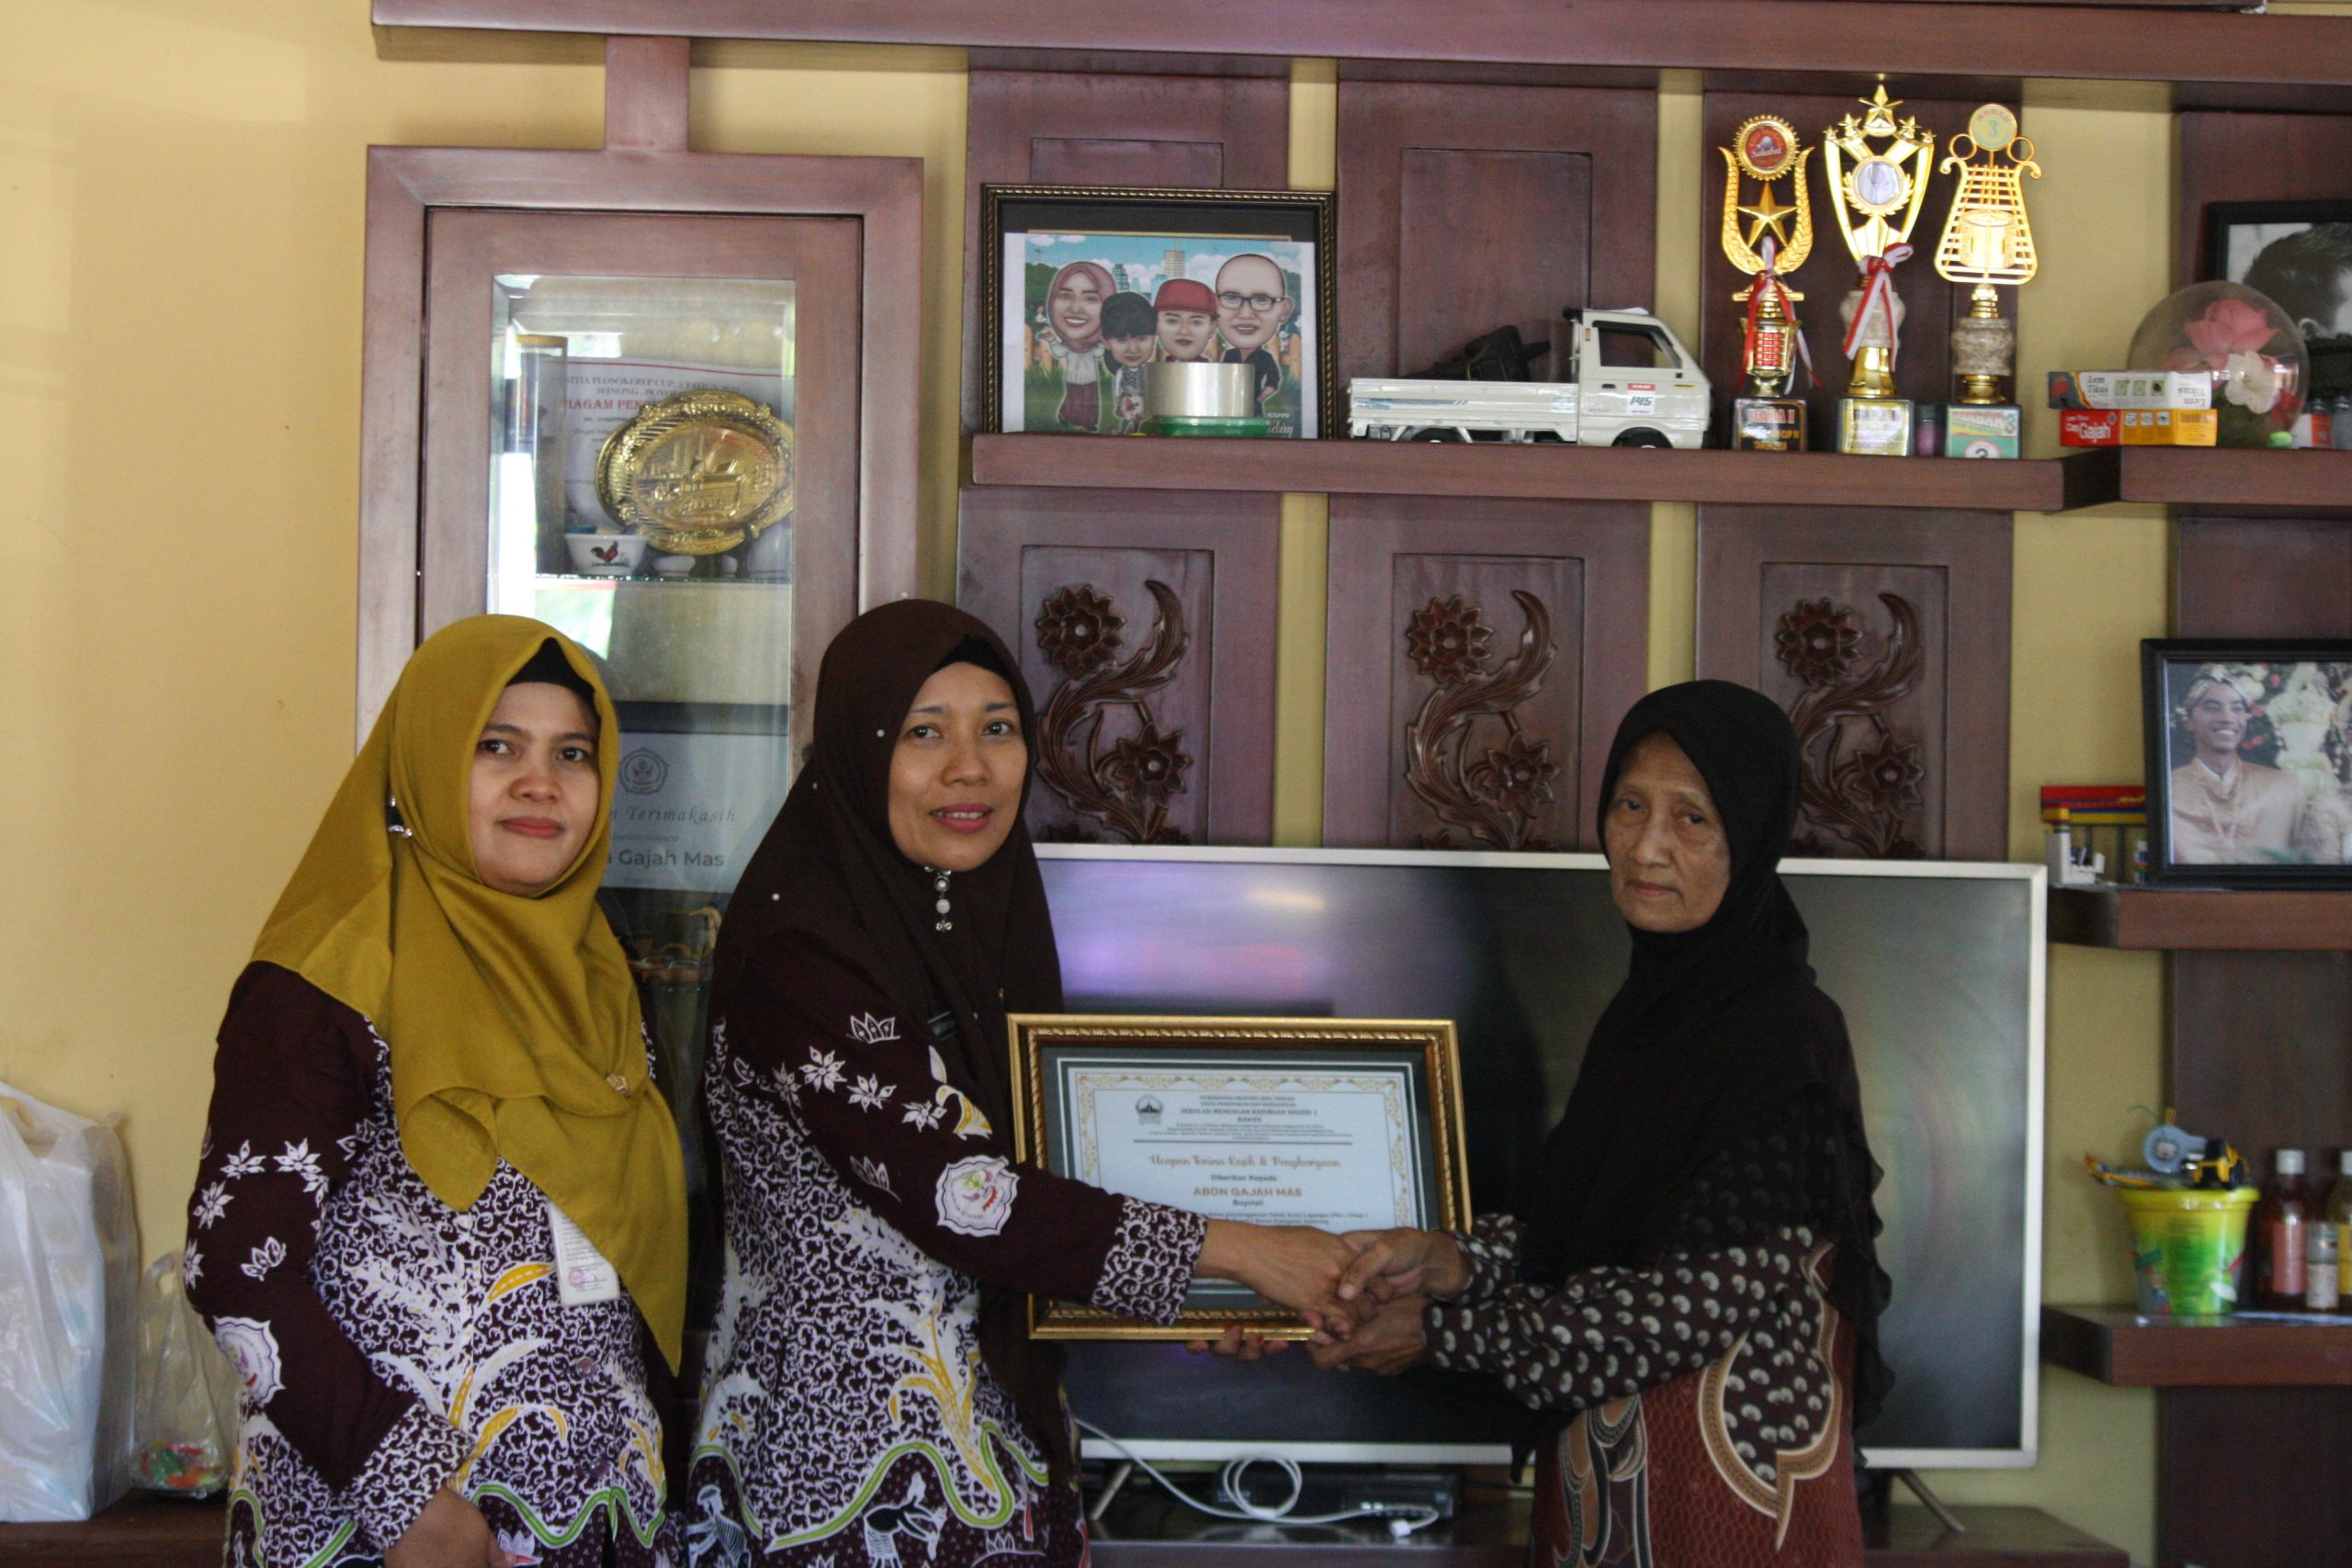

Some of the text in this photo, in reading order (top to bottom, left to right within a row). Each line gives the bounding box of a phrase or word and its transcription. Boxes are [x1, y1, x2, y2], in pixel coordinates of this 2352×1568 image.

[1630, 396, 1653, 407] 145
[2079, 422, 2111, 443] Gajah
[618, 849, 677, 869] Gajah
[684, 852, 724, 866] Mas
[1193, 1187, 1303, 1197] ABON GAJAH MAS
